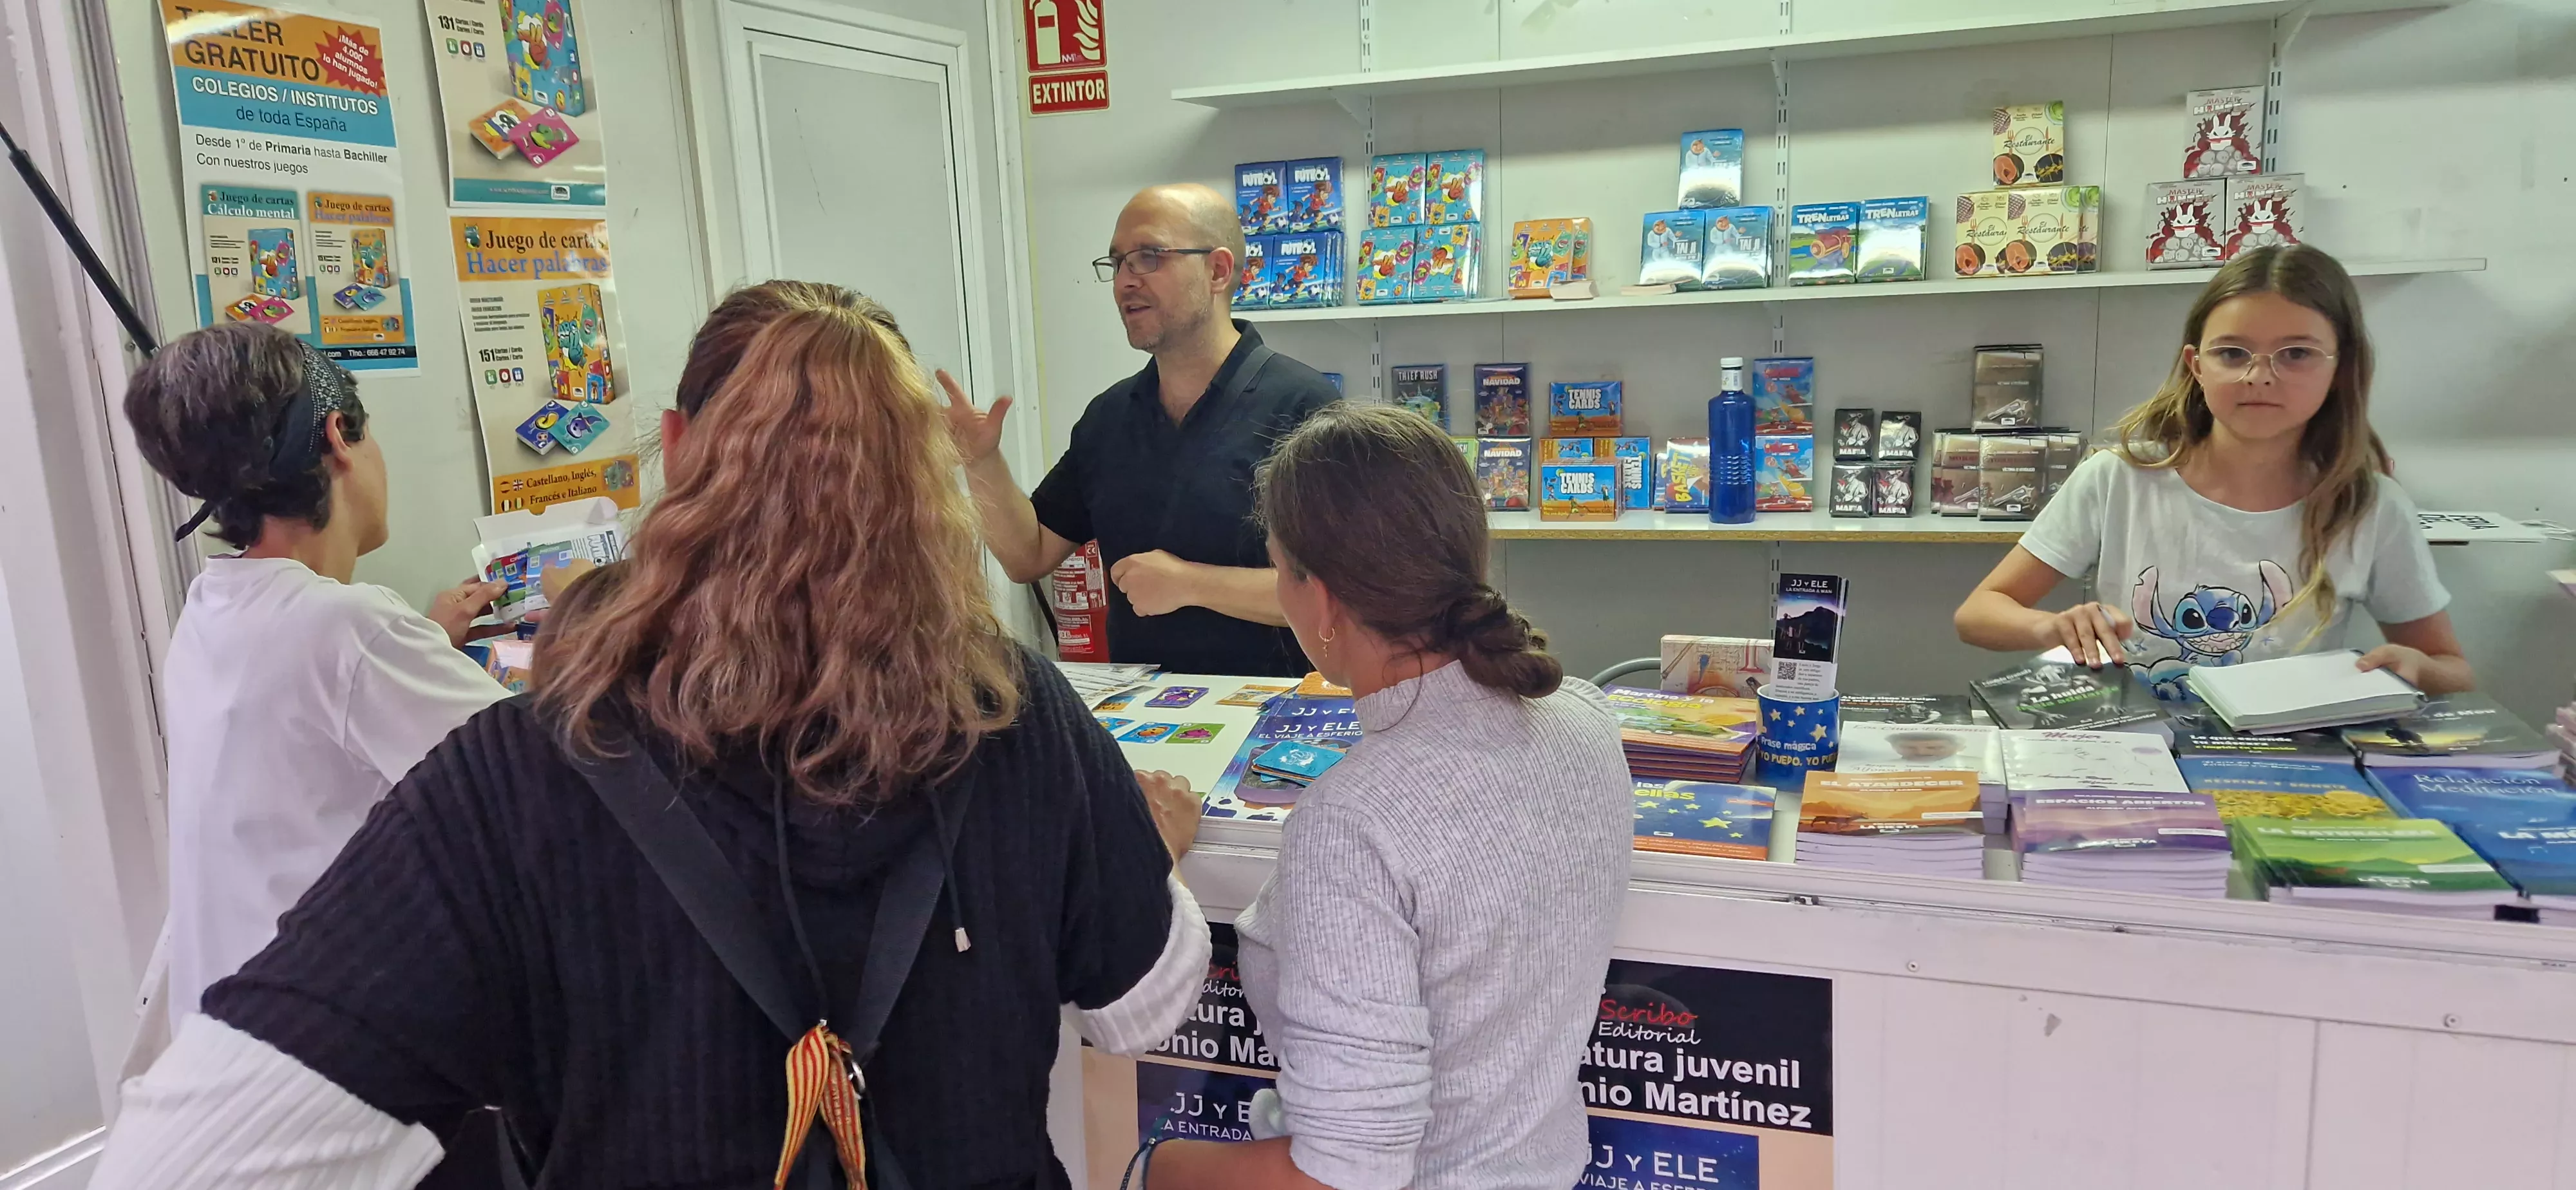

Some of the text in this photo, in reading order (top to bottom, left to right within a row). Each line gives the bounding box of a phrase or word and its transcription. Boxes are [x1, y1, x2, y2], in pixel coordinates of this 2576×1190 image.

[437, 15, 455, 30] 131
[342, 45, 363, 62] 4.000
[359, 44, 369, 55] de
[185, 40, 320, 81] GRATUITO
[334, 52, 368, 75] alumnos
[323, 53, 378, 89] lo han jugado!
[192, 76, 279, 102] COLEGIOS
[290, 90, 378, 115] INSTITUTOS
[1033, 79, 1106, 104] EXTINTOR
[236, 106, 346, 131] de toda España
[196, 134, 231, 148] Desde
[249, 139, 261, 151] de
[265, 141, 310, 156] Primaria
[314, 146, 341, 159] hasta
[344, 148, 388, 163] Bachiller
[2003, 138, 2055, 149] Restaurante
[197, 153, 308, 175] Con nuestros juegos
[220, 192, 294, 206] Juego de cartas
[325, 199, 350, 211] Juego
[353, 202, 363, 211] de
[207, 203, 295, 220] Cálculo mental
[1797, 212, 1826, 223] TREN
[1866, 208, 1895, 219] TREN
[2017, 225, 2069, 234] Restaurante
[486, 230, 556, 254] Juego de
[466, 252, 609, 280] Hacer palabras
[478, 348, 495, 362] 151
[1399, 370, 1437, 381] THIEF RUSH
[1483, 377, 1520, 386] NAVIDAD
[1568, 388, 1602, 400] TENNIS
[1569, 399, 1600, 410] CARDS
[526, 469, 596, 489] Castellano, Inglés,
[1560, 473, 1595, 484] TENNIS
[1632, 456, 1642, 489] TENNIS
[1671, 452, 1692, 502] BASKET
[529, 491, 560, 505] Francés
[568, 486, 597, 497] Italiano
[1560, 483, 1593, 494] CARDS
[1613, 689, 1679, 700] Martina
[2050, 686, 2095, 699] huida
[1293, 708, 1317, 716] JJ
[1276, 724, 1302, 733] JJ
[1323, 721, 1359, 731] ELE
[1784, 741, 1816, 751] mágica
[1806, 757, 1819, 766] YO
[1634, 789, 1695, 800] ellas
[1600, 999, 1698, 1026] Scribo
[1598, 1021, 1701, 1045] Editorial
[1674, 1048, 1801, 1088] juvenil
[1170, 1092, 1227, 1119] JJ Y
[1645, 1081, 1812, 1128] Martínez
[1179, 1121, 1251, 1141] ENTRADA
[1625, 1151, 1719, 1183] Y ELE
[1579, 1172, 1627, 1190] VIAJE
